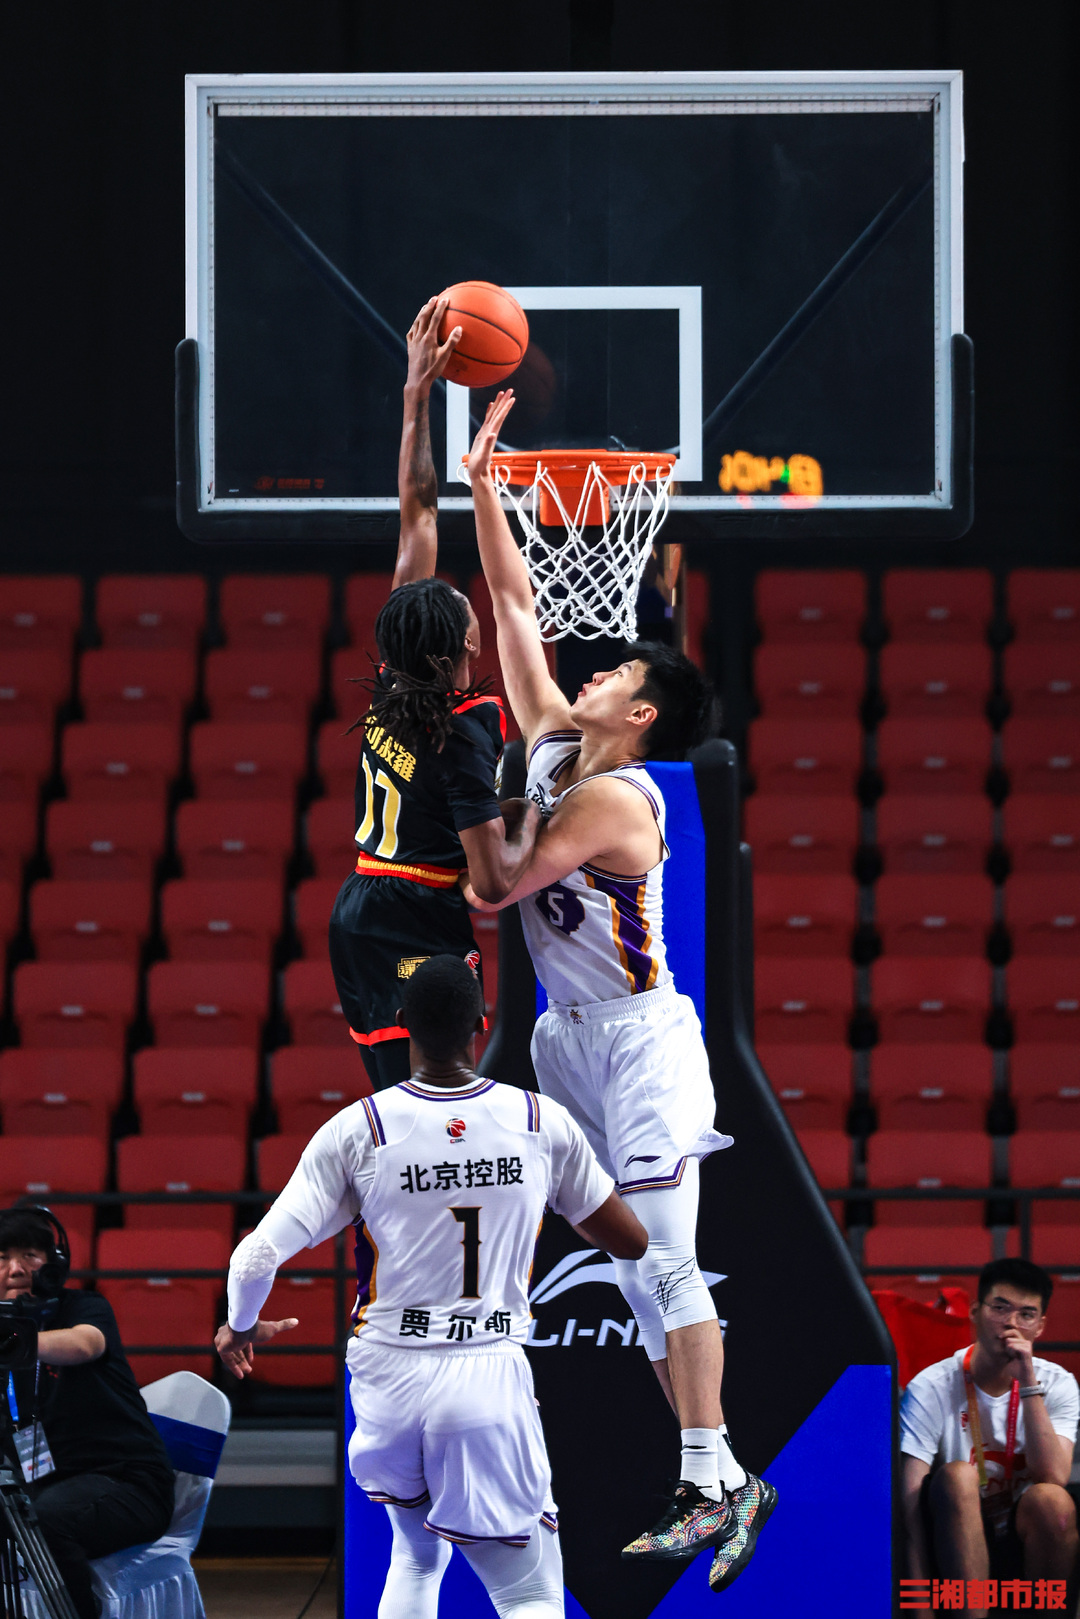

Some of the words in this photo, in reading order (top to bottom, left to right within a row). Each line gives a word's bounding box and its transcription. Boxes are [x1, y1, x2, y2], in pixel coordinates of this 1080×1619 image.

[547, 891, 565, 927] 5
[400, 1156, 524, 1194] 北京控股
[446, 1206, 483, 1300] 1
[399, 1308, 512, 1342] 贾尔斯
